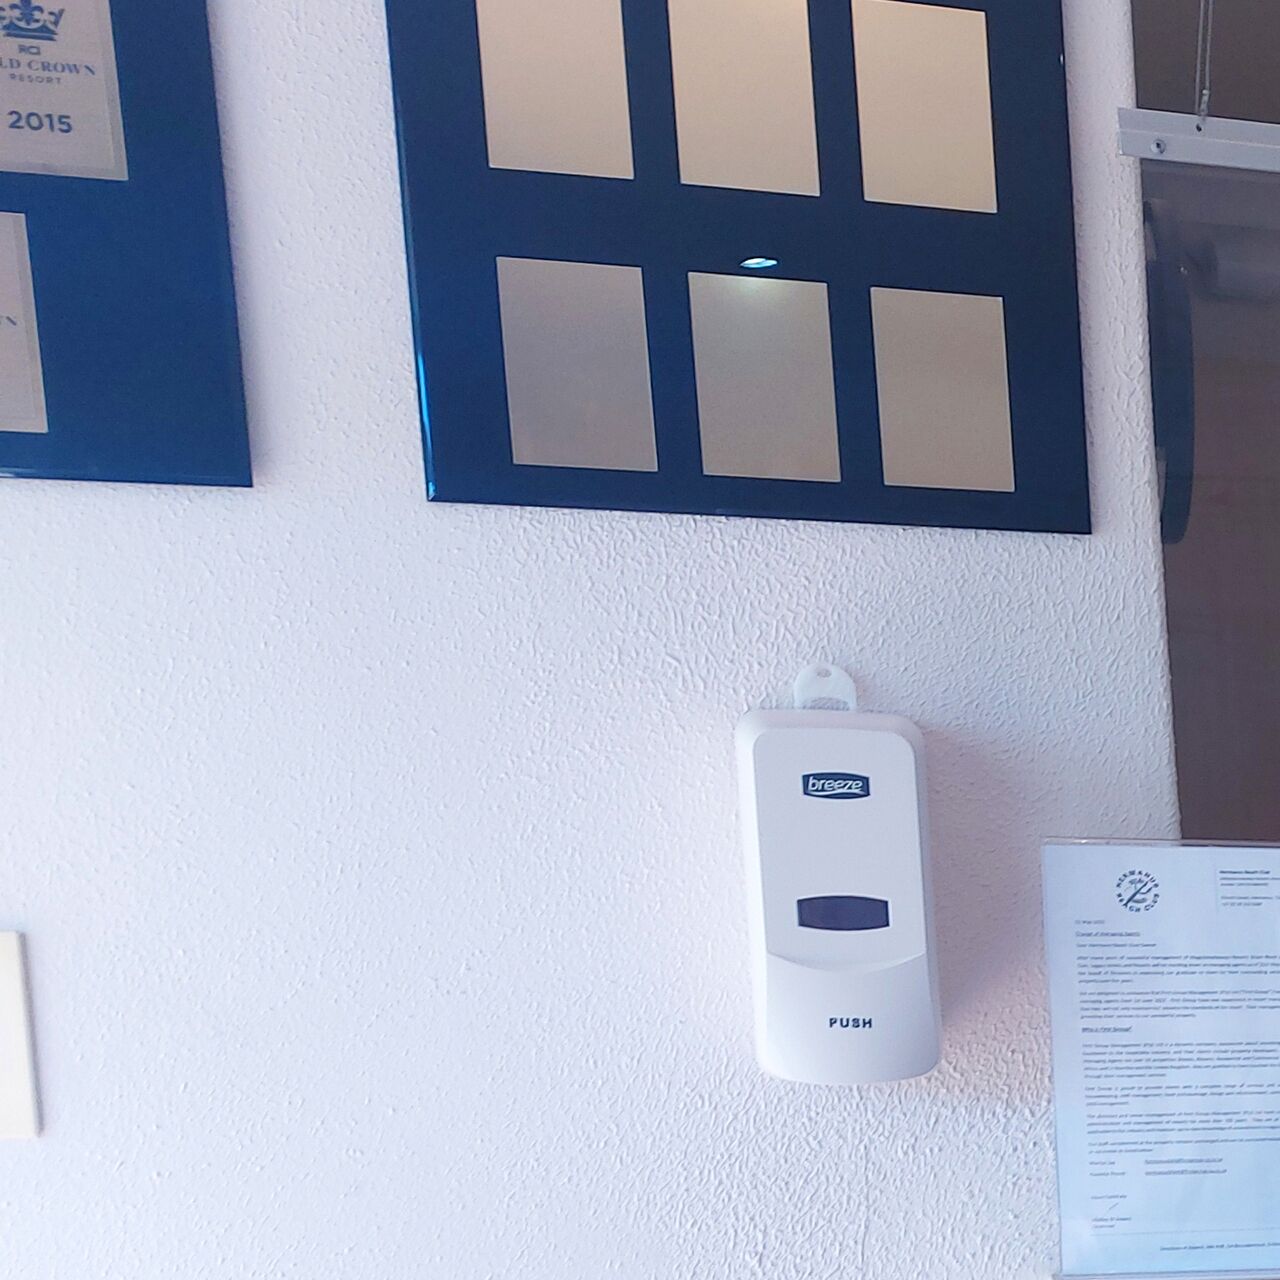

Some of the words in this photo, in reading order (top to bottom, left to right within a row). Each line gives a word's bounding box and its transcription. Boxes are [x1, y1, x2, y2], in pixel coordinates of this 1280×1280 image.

[27, 60, 96, 76] CROWN
[9, 73, 62, 84] RESORT
[7, 110, 73, 134] 2015
[808, 776, 863, 791] breeze
[829, 1017, 873, 1029] PUSH
